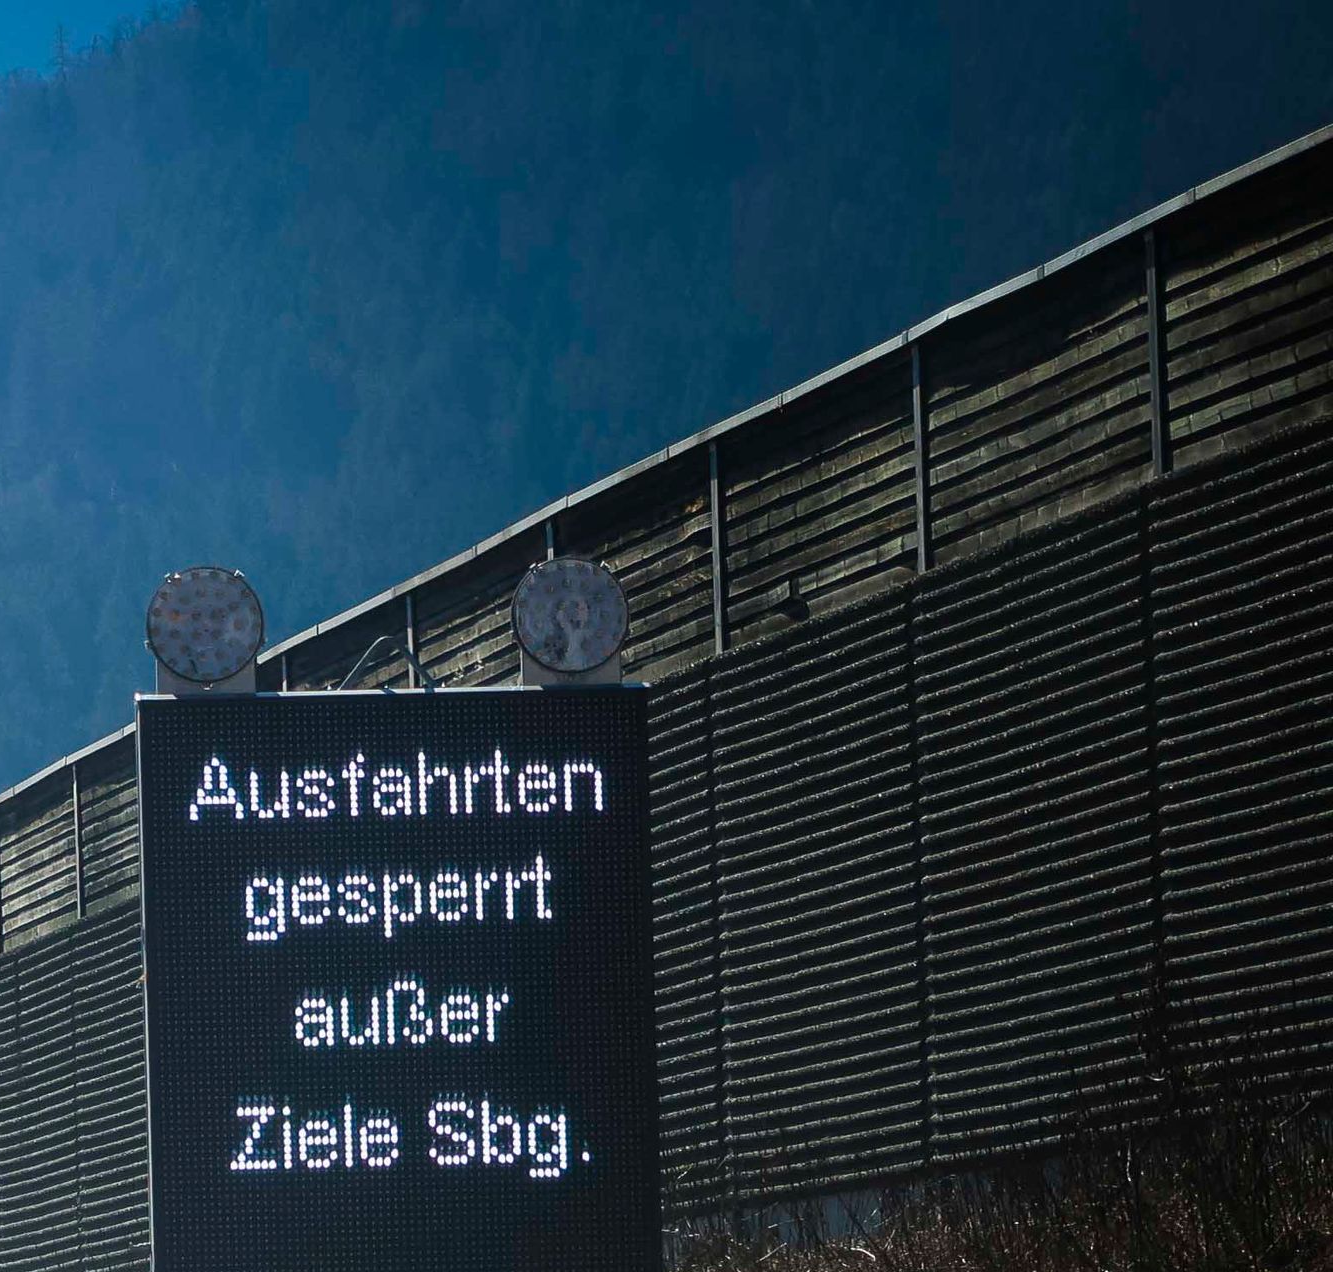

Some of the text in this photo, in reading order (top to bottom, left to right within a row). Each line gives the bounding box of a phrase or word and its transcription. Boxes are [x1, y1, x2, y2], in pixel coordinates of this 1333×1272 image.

[189, 748, 605, 821] Ausfahrten
[245, 852, 553, 943] gesperrt
[294, 979, 511, 1047] außer
[230, 1100, 592, 1179] Ziele Sbg.
